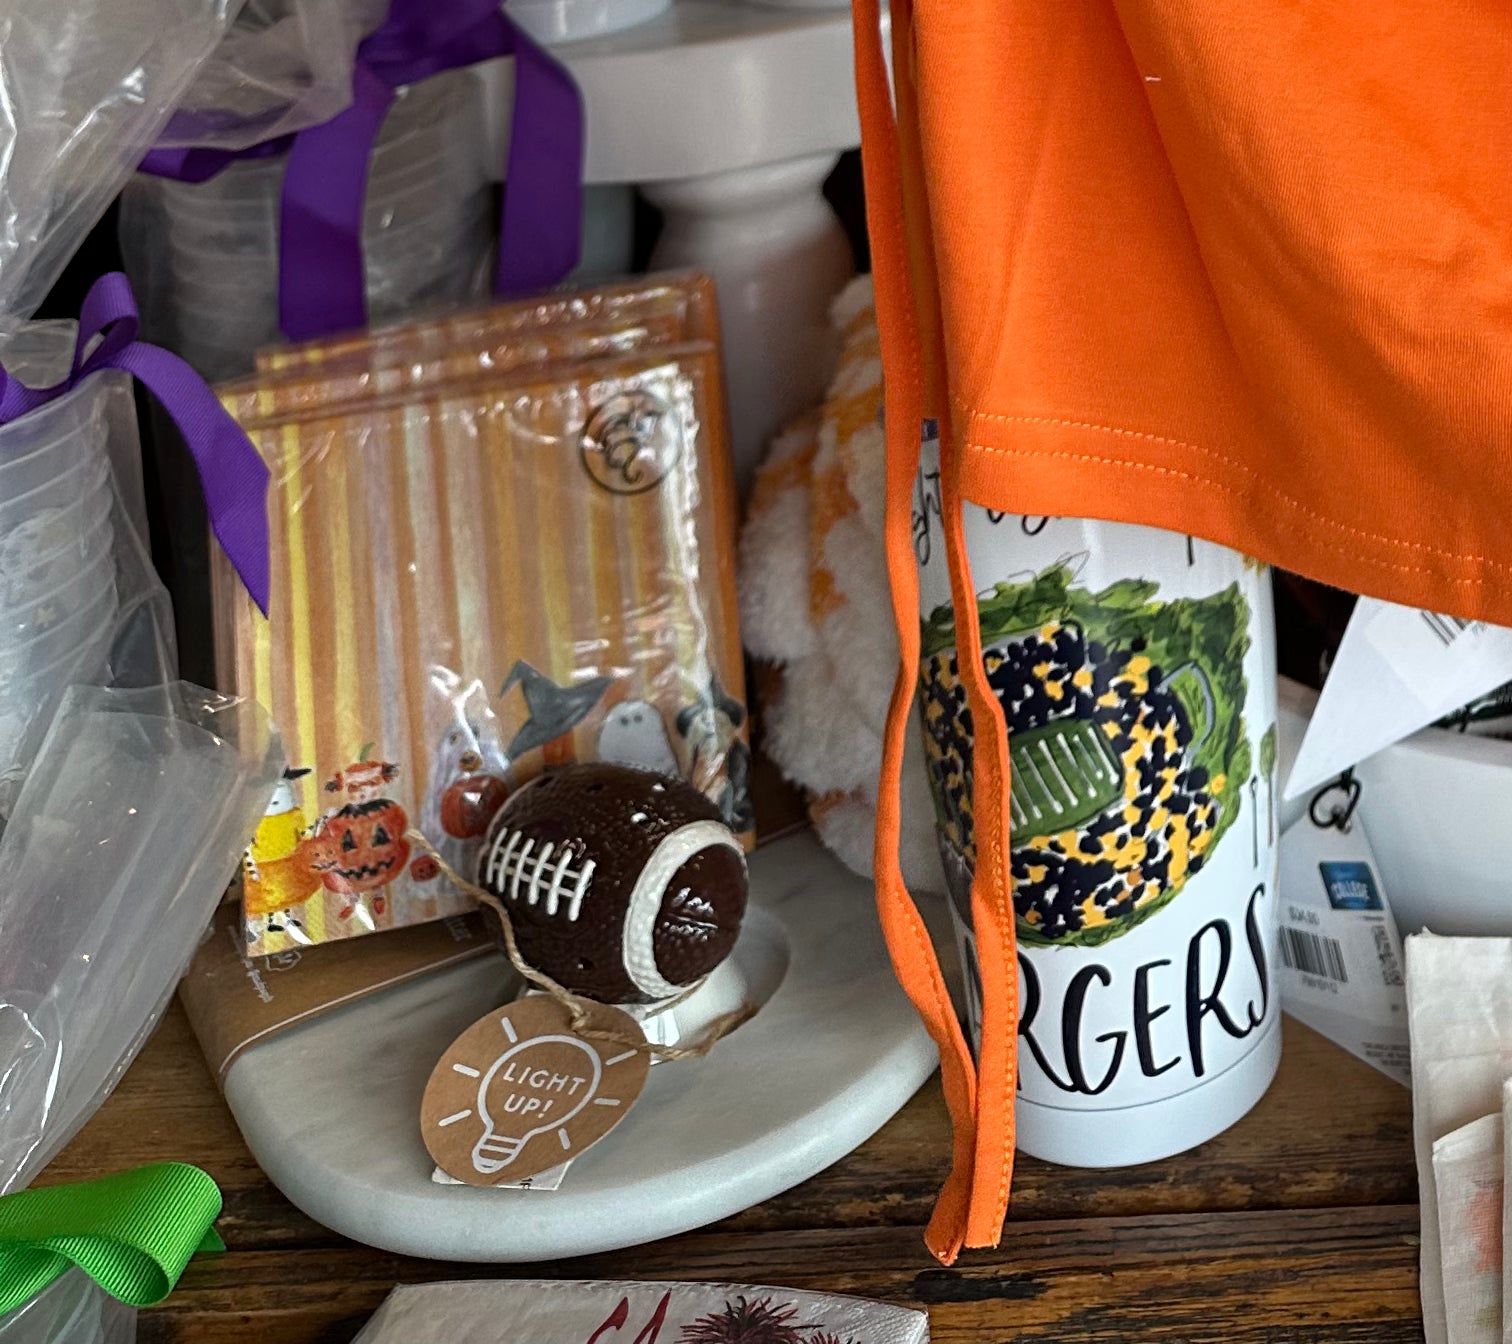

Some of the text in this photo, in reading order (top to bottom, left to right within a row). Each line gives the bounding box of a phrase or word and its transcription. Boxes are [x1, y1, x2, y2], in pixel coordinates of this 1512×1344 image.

[964, 881, 1269, 1096] RGERS
[502, 1062, 586, 1096] LIGHT
[503, 1093, 554, 1118] UP!
